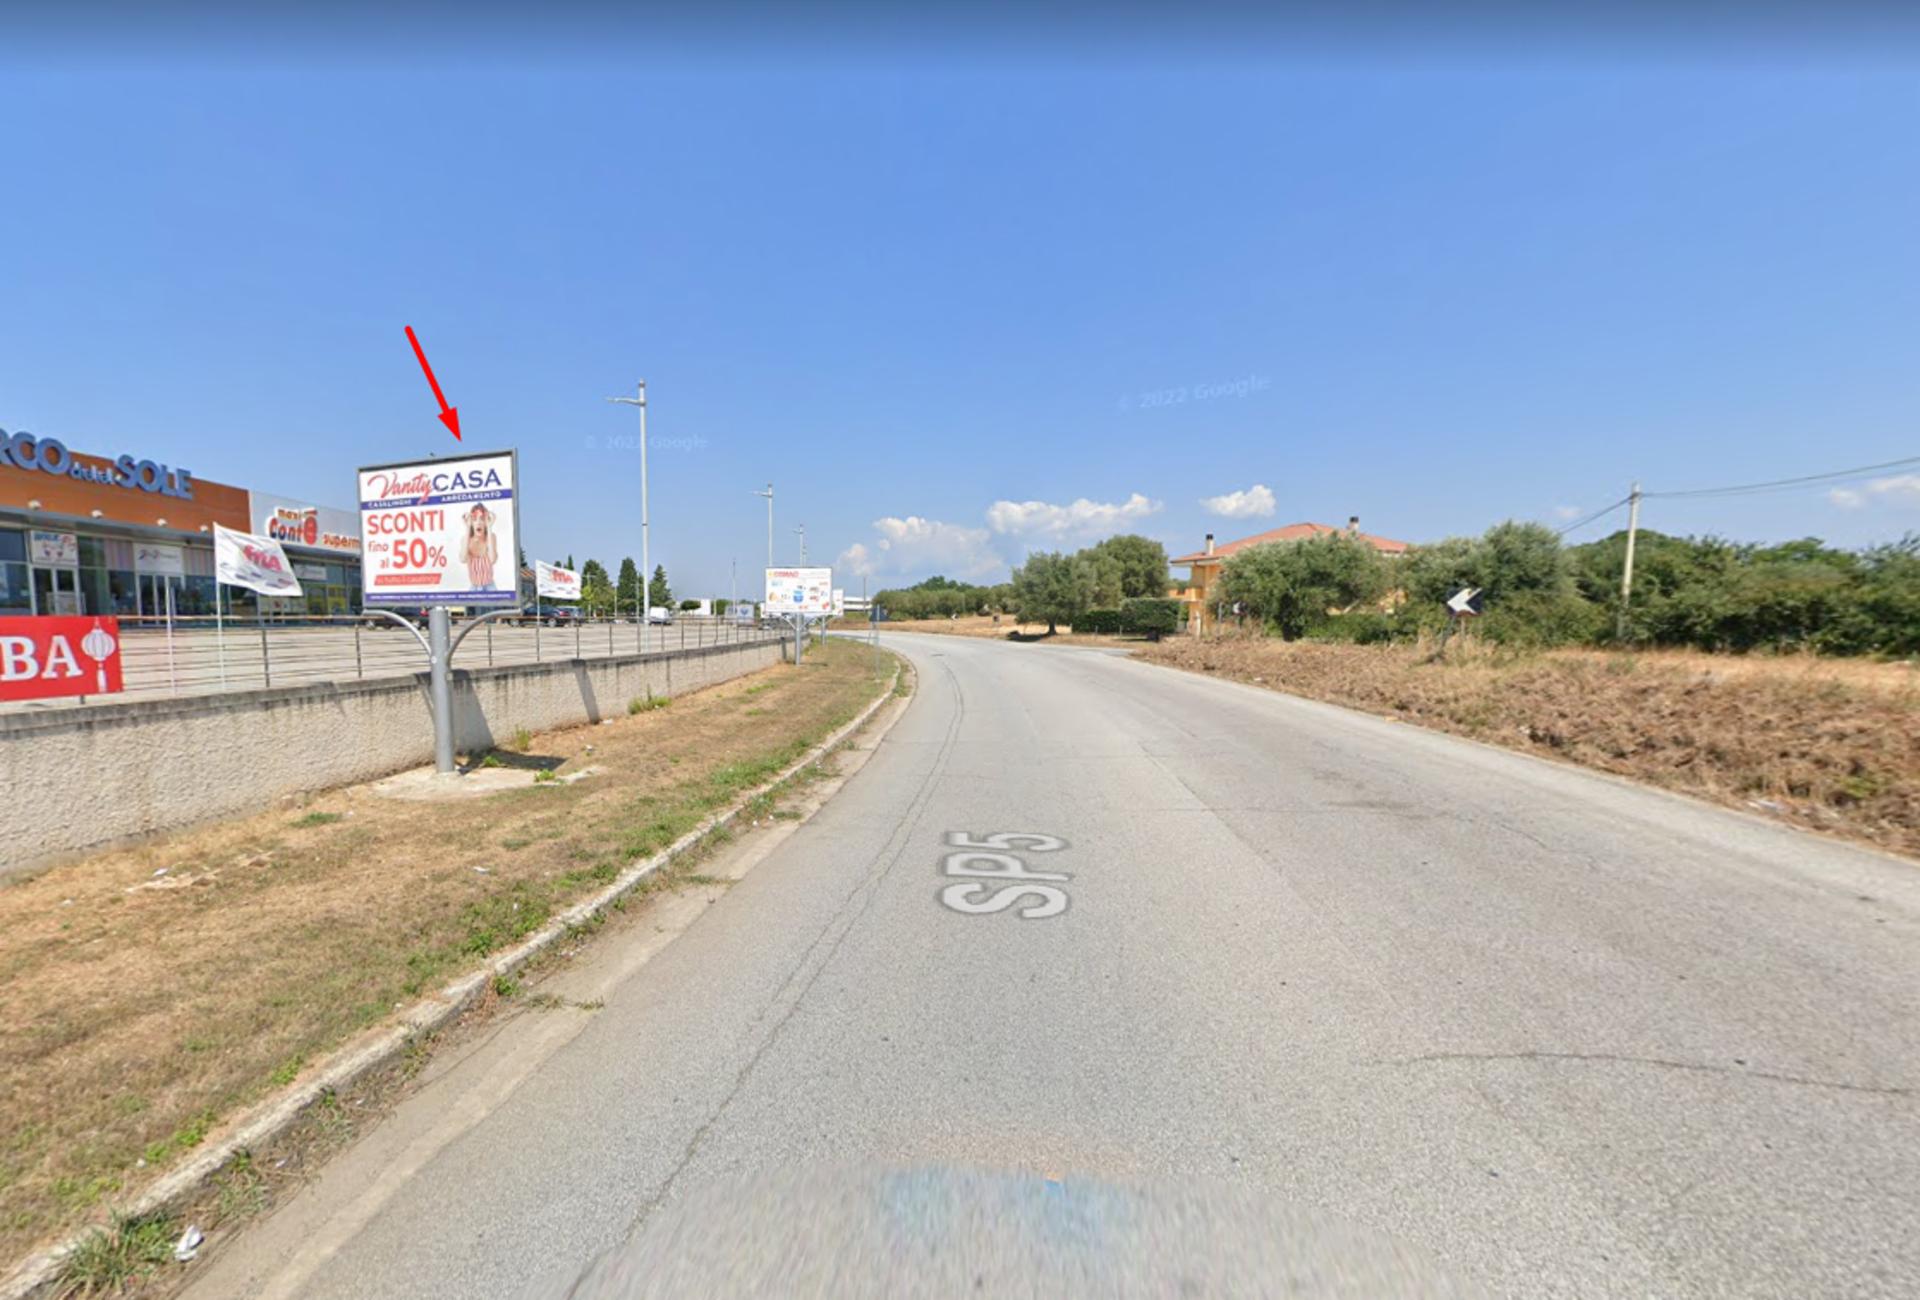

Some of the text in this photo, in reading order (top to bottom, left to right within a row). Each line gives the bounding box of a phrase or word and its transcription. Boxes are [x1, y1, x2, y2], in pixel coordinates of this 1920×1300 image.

[115, 454, 193, 500] SOLE
[433, 468, 501, 492] CASA
[367, 510, 444, 535] SCONTI
[368, 541, 388, 553] fino
[380, 538, 447, 569] al 50%
[0, 634, 84, 682] BA
